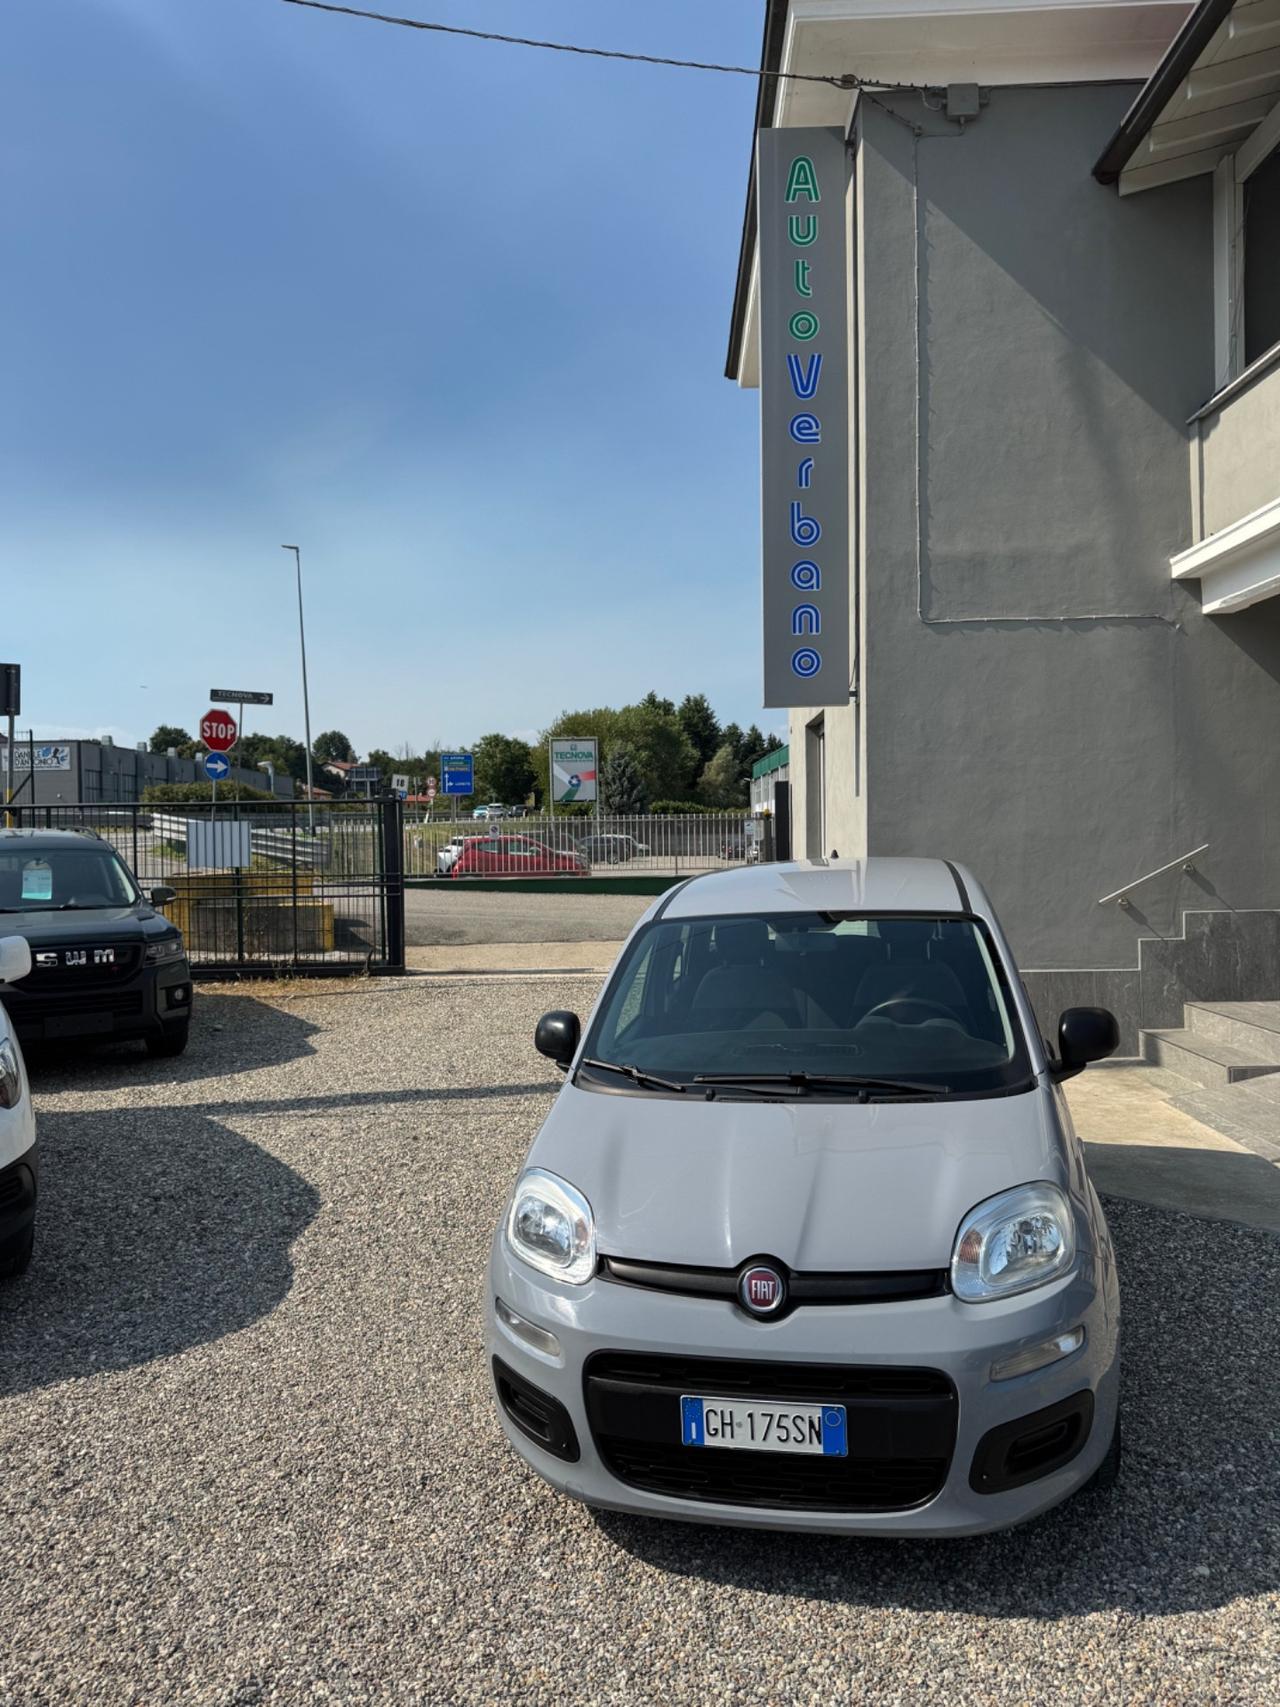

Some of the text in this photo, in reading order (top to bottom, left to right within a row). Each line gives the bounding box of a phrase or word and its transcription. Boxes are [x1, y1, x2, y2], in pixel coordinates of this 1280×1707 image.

[217, 690, 254, 699] TECNOVA
[202, 721, 235, 740] STOP
[554, 751, 594, 760] TECNOVA
[751, 1279, 775, 1301] FIAT
